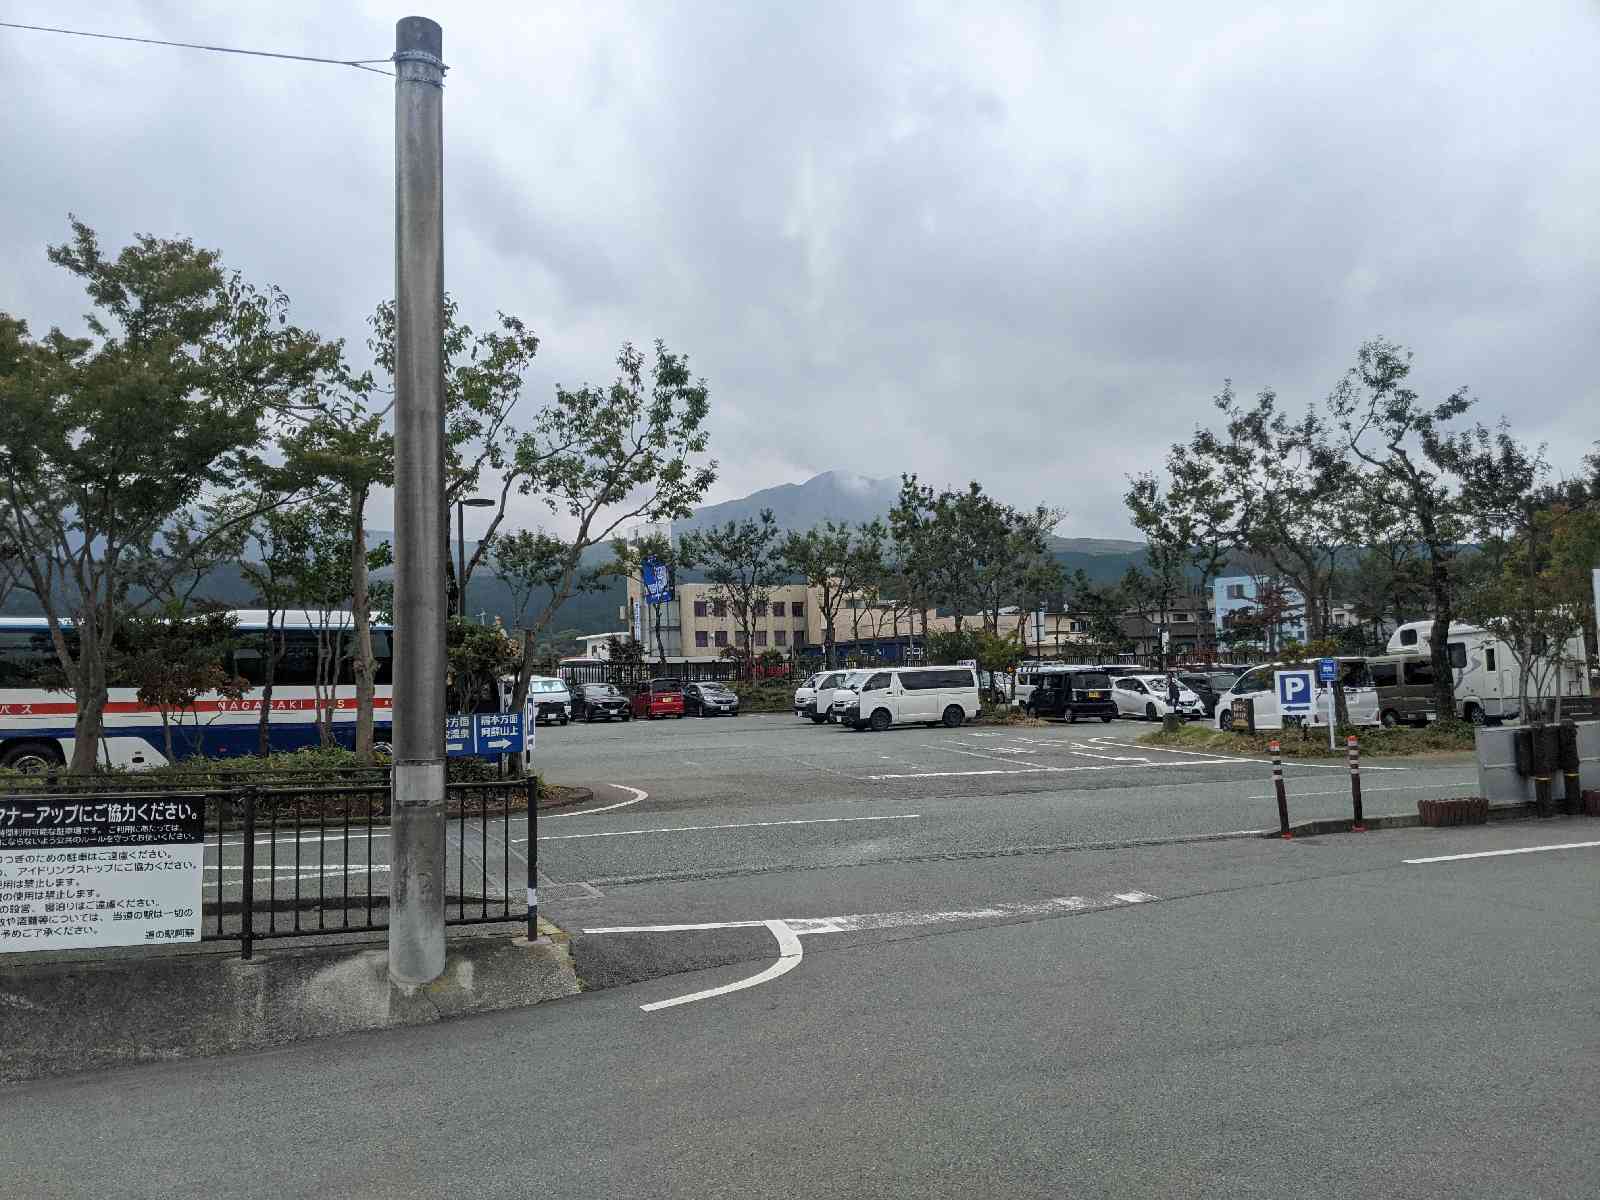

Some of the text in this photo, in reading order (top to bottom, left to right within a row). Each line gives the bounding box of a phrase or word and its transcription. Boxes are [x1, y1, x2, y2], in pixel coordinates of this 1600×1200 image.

[1285, 677, 1304, 701] P
[481, 726, 519, 737] 阿蘇山上
[0, 850, 171, 863] つぎのための駐車はご遠慮ください。
[0, 861, 196, 877] 、アイドリングストップにご協力ください。
[0, 878, 80, 890] 用は禁止します。
[0, 889, 100, 901] の使用は禁止します。
